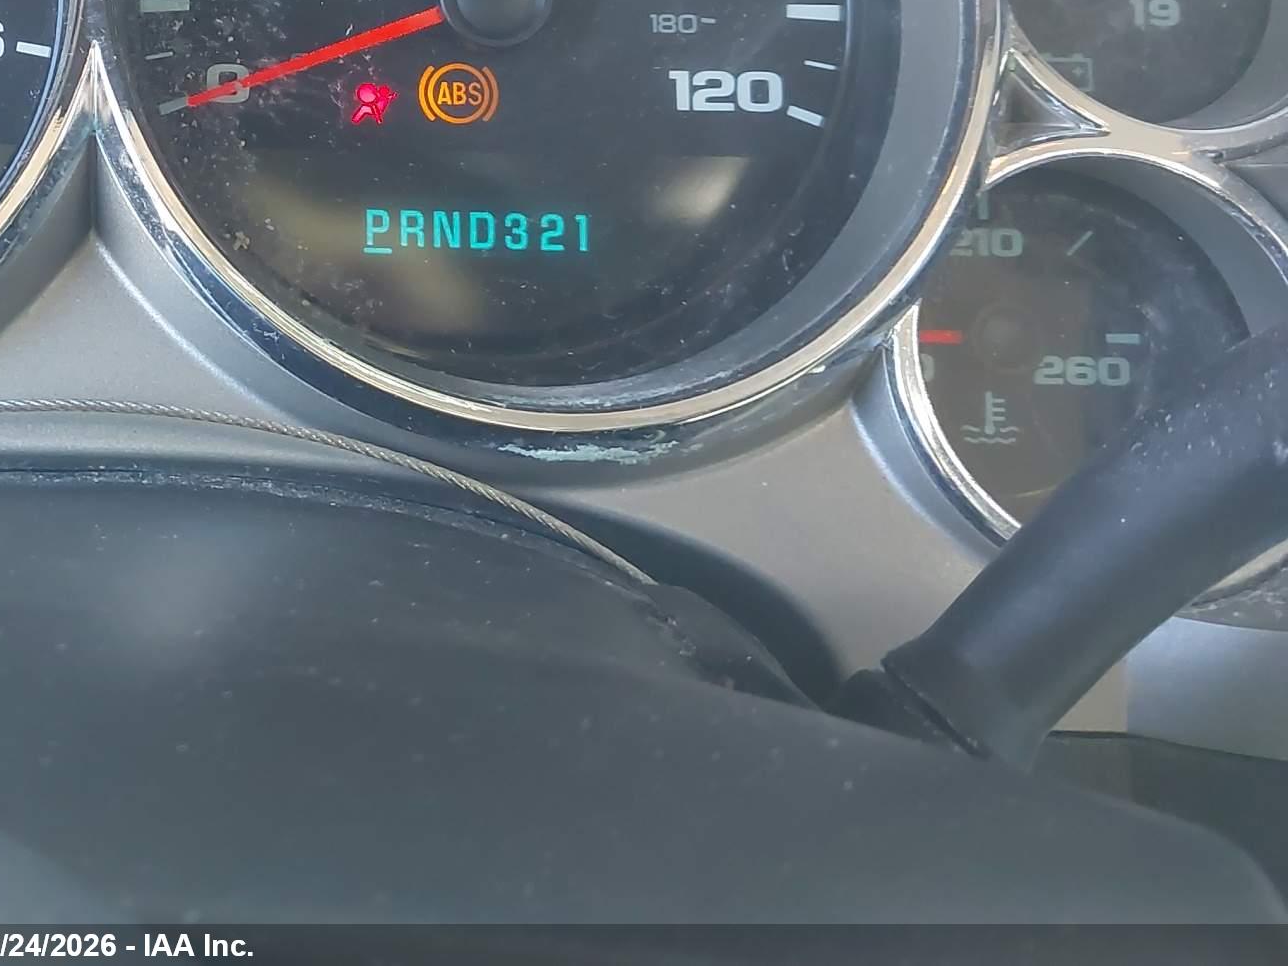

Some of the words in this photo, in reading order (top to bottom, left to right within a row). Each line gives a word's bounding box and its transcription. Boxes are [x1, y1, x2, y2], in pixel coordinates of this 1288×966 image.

[650, 14, 699, 33] 180
[206, 63, 251, 104] 0
[437, 81, 483, 106] ABS
[668, 70, 783, 112] 120
[1033, 355, 1130, 386] 260
